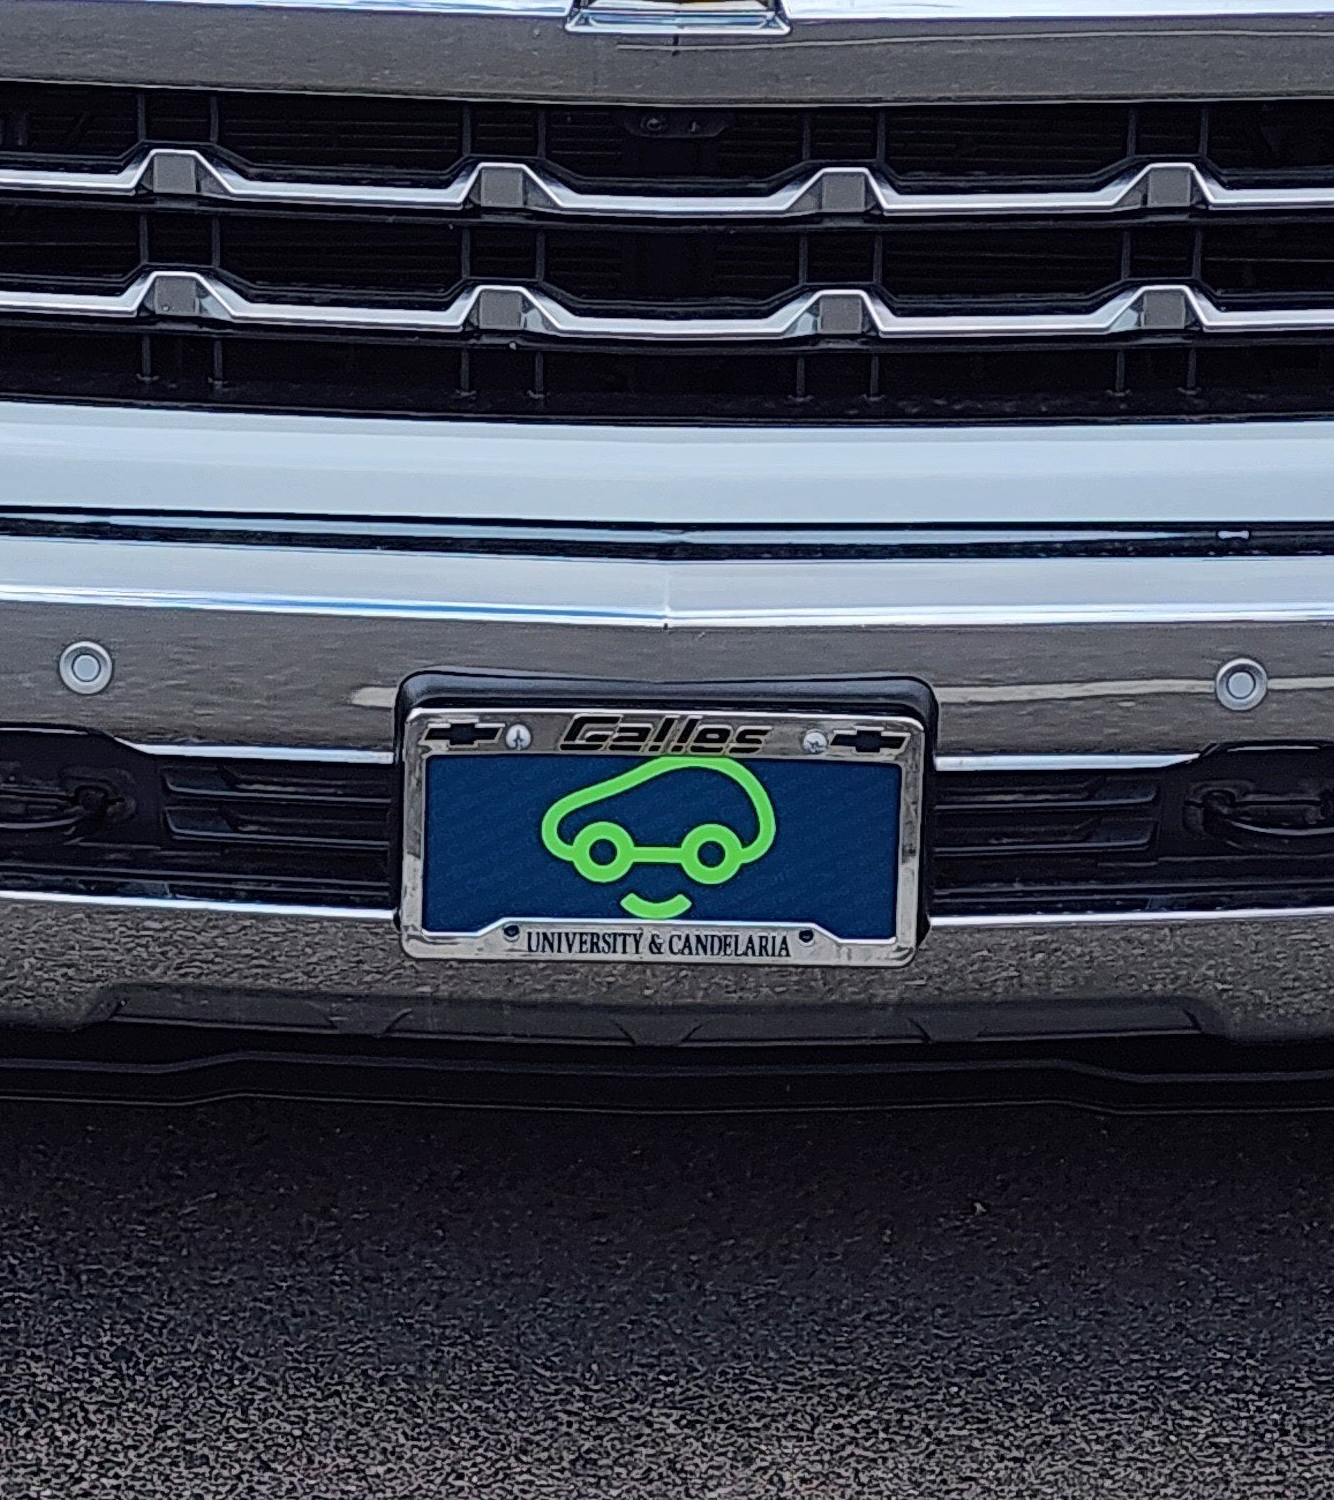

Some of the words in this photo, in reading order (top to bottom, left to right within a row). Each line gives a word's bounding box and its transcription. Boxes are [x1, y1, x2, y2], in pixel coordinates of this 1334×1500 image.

[559, 714, 772, 754] Galles
[526, 930, 644, 954] UNIVERSITY
[648, 932, 665, 954] &
[668, 933, 792, 957] CANDELARIA
